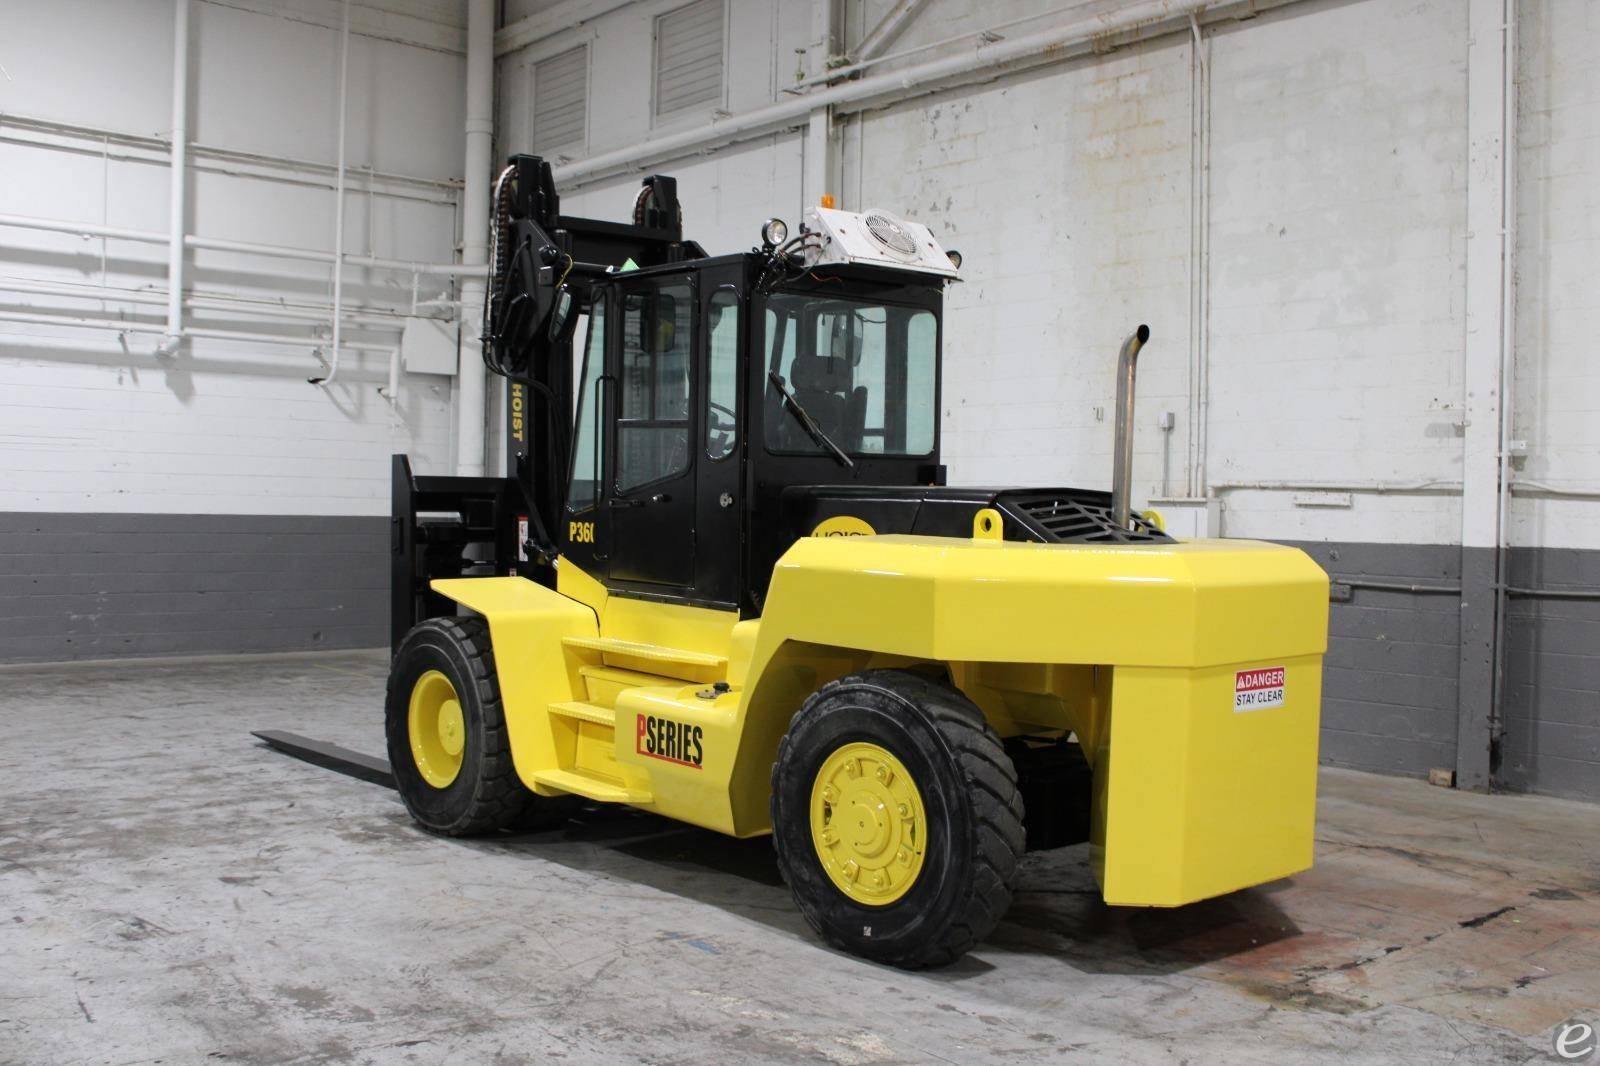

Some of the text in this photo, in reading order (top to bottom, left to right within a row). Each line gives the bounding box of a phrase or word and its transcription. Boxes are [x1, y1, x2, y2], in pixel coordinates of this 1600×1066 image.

[512, 383, 523, 442] HOIST
[1245, 670, 1284, 688] DANGER
[1236, 689, 1283, 706] STAY CLEAR
